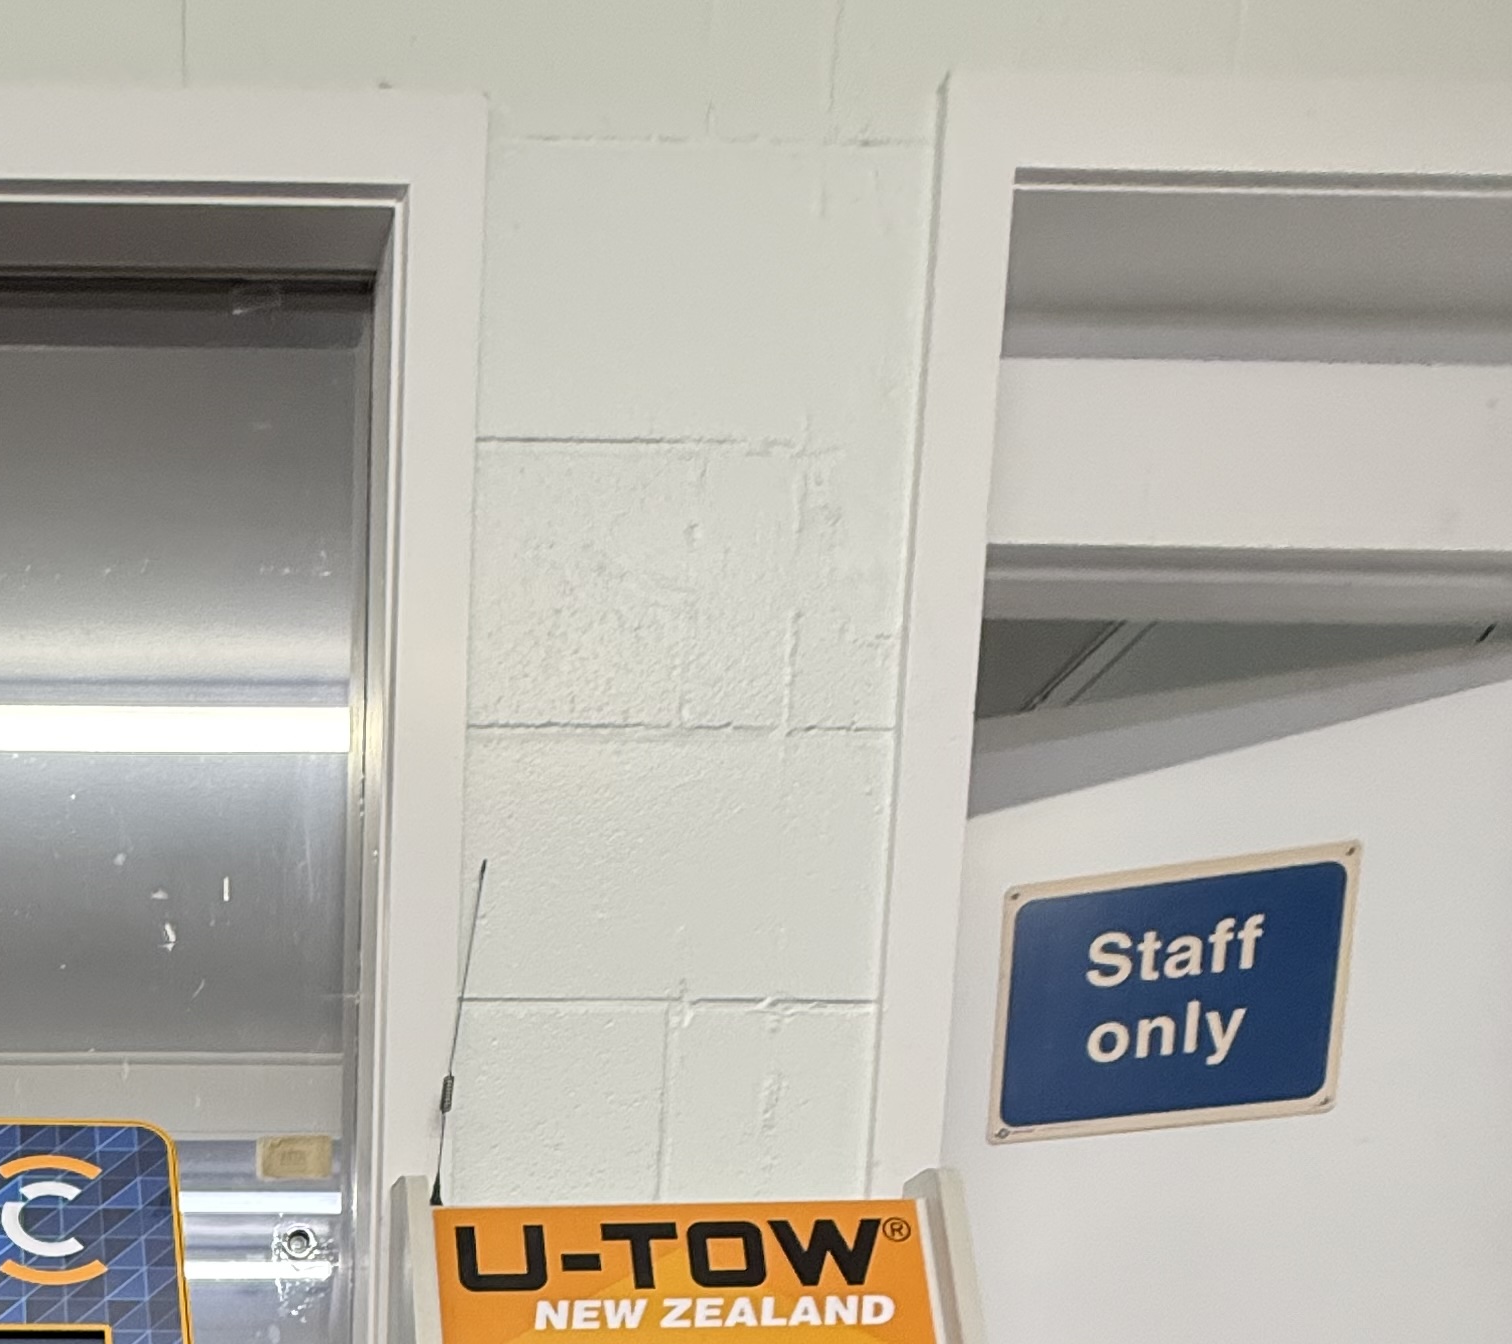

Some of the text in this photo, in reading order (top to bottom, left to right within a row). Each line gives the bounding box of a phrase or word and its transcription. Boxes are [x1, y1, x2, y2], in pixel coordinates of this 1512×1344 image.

[1086, 913, 1265, 987] Staff
[1086, 999, 1247, 1066] only
[533, 1294, 895, 1330] NEW ZEALAND
